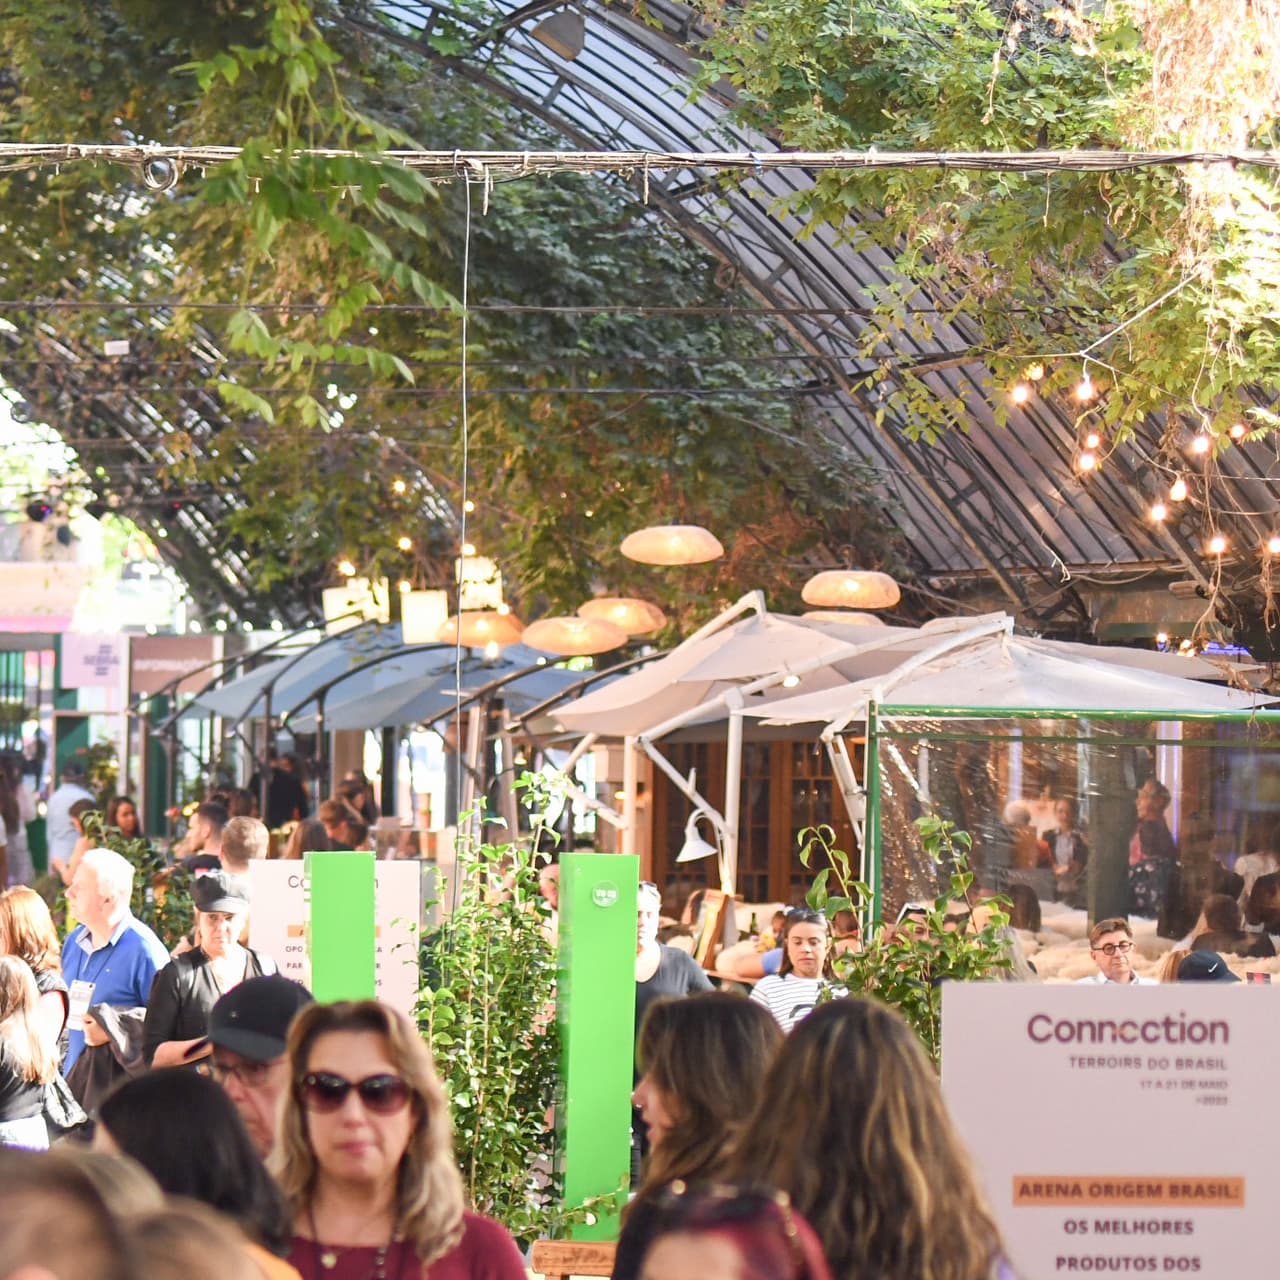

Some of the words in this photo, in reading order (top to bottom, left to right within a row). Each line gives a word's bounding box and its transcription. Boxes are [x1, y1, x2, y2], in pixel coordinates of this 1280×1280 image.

[1069, 1056, 1142, 1069] TERROIRS
[1147, 1057, 1170, 1071] DO
[1175, 1057, 1228, 1071] BRASIL
[1018, 1183, 1083, 1198] ARENA
[1088, 1183, 1163, 1198] ORIGEM
[1063, 1219, 1089, 1235] OS
[1093, 1219, 1194, 1235] MELHORES
[1055, 1256, 1158, 1272] PRODUTOS
[1163, 1256, 1202, 1272] DOS
